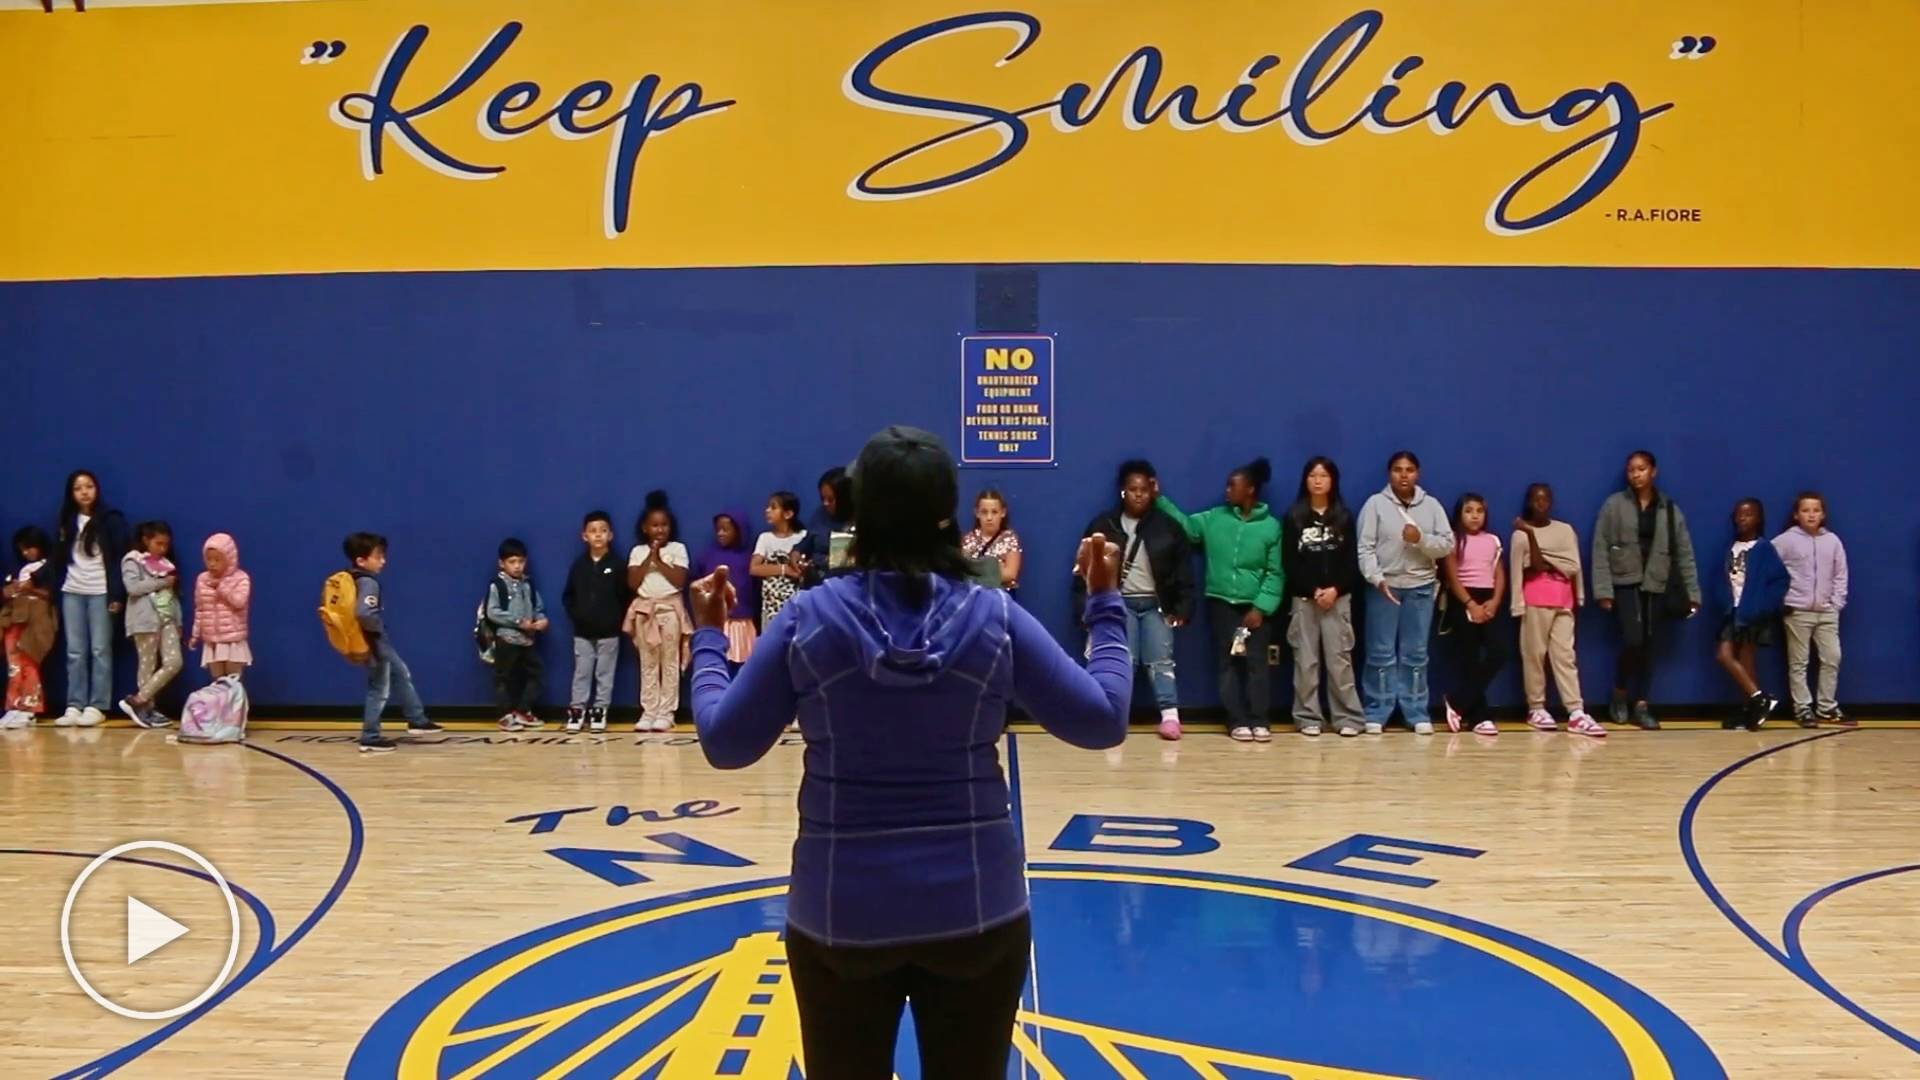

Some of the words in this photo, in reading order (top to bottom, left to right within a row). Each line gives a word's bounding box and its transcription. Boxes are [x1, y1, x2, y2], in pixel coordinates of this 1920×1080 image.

[1616, 208, 1702, 222] R.A.FIORE
[985, 348, 1034, 370] NO
[977, 376, 1039, 385] UNAUTHORIZED
[984, 388, 1031, 398] EQUIPMENT
[977, 404, 998, 414] FOOD
[1000, 404, 1011, 414] OR
[1013, 404, 1038, 414] DRINK
[966, 416, 998, 425] BEYOND
[1000, 416, 1020, 425] THIS
[979, 431, 1009, 441] TENNIS
[1011, 431, 1037, 441] SHOES
[998, 443, 1019, 452] ONLY
[505, 800, 740, 834] The
